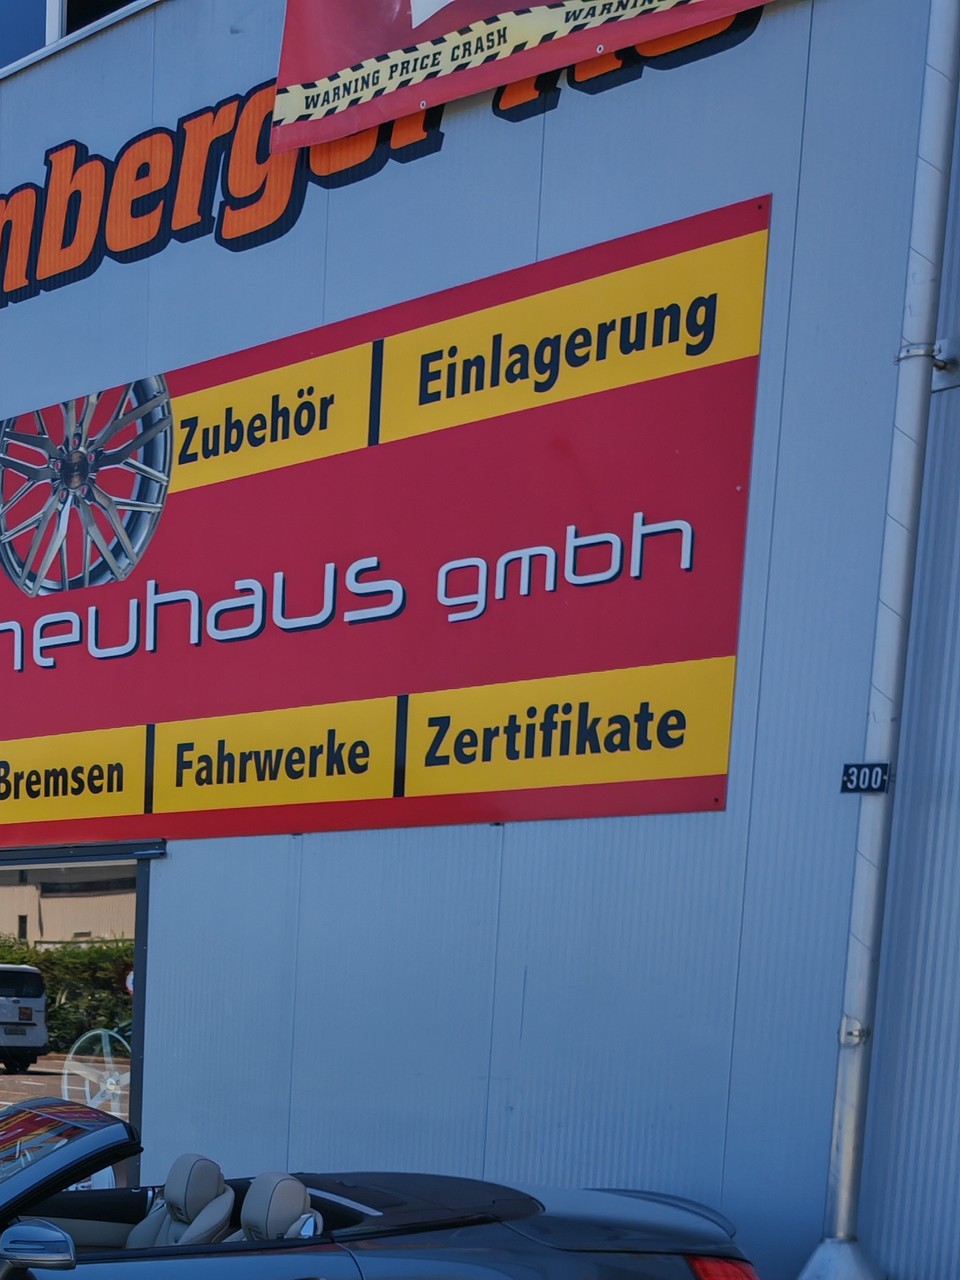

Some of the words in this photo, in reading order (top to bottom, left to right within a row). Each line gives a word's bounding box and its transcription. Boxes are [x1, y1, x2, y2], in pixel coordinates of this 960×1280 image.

[304, 69, 381, 110] WARNING
[388, 51, 442, 80] PRICE
[450, 26, 508, 62] CRASH
[418, 293, 718, 406] Einlagerung
[178, 386, 335, 465] Zubehör
[436, 512, 693, 622] gmbh
[175, 729, 370, 788] Fahrwerke
[424, 701, 687, 767] Zertifikate
[847, 766, 882, 789] 300
